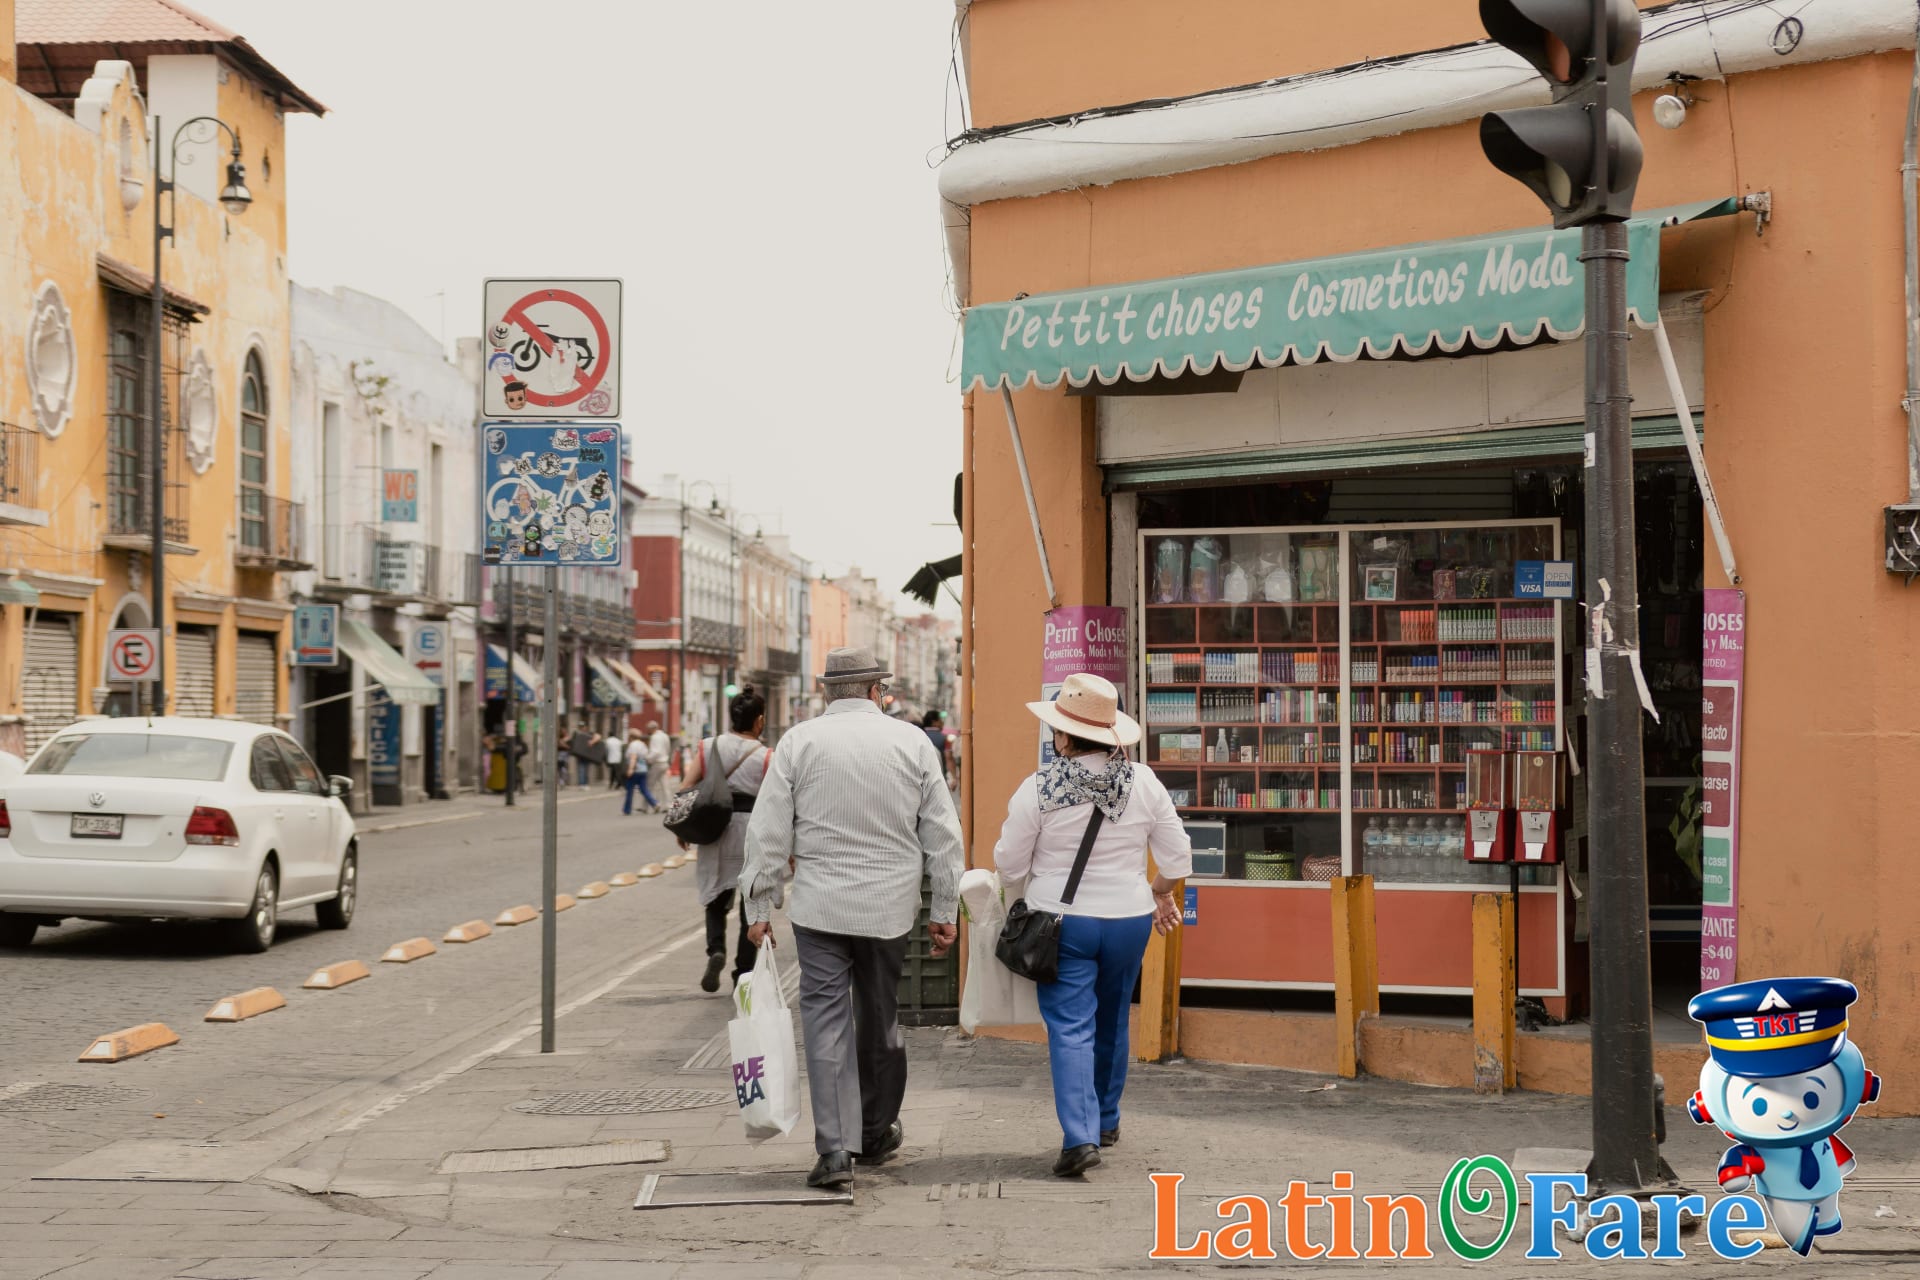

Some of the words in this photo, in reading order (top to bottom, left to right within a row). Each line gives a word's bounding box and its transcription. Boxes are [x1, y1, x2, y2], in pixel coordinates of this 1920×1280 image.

[1000, 294, 1137, 350] Pettit
[1146, 288, 1263, 340] choses
[1287, 257, 1468, 321] Cosmeticos
[1478, 235, 1574, 296] Moda
[384, 471, 416, 501] WC
[1520, 584, 1542, 592] VISA
[420, 632, 436, 649] E
[733, 1055, 765, 1086] PUE
[736, 1078, 766, 1109] BLA
